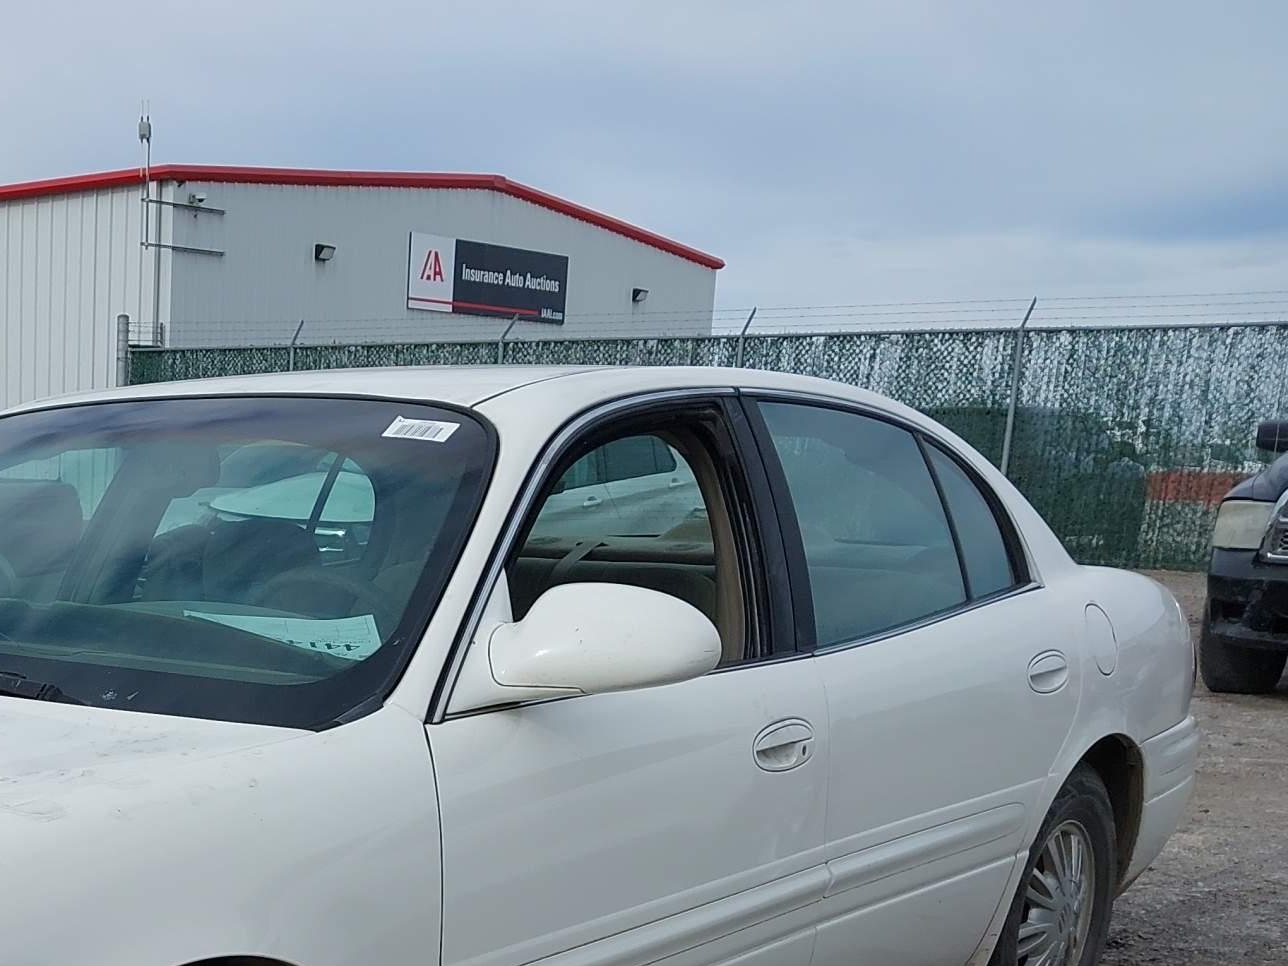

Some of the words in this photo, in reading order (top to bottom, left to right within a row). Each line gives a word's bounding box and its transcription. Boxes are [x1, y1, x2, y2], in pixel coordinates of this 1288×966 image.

[462, 264, 504, 285] Insurance
[505, 270, 523, 287] Auto
[525, 274, 560, 292] Auctions
